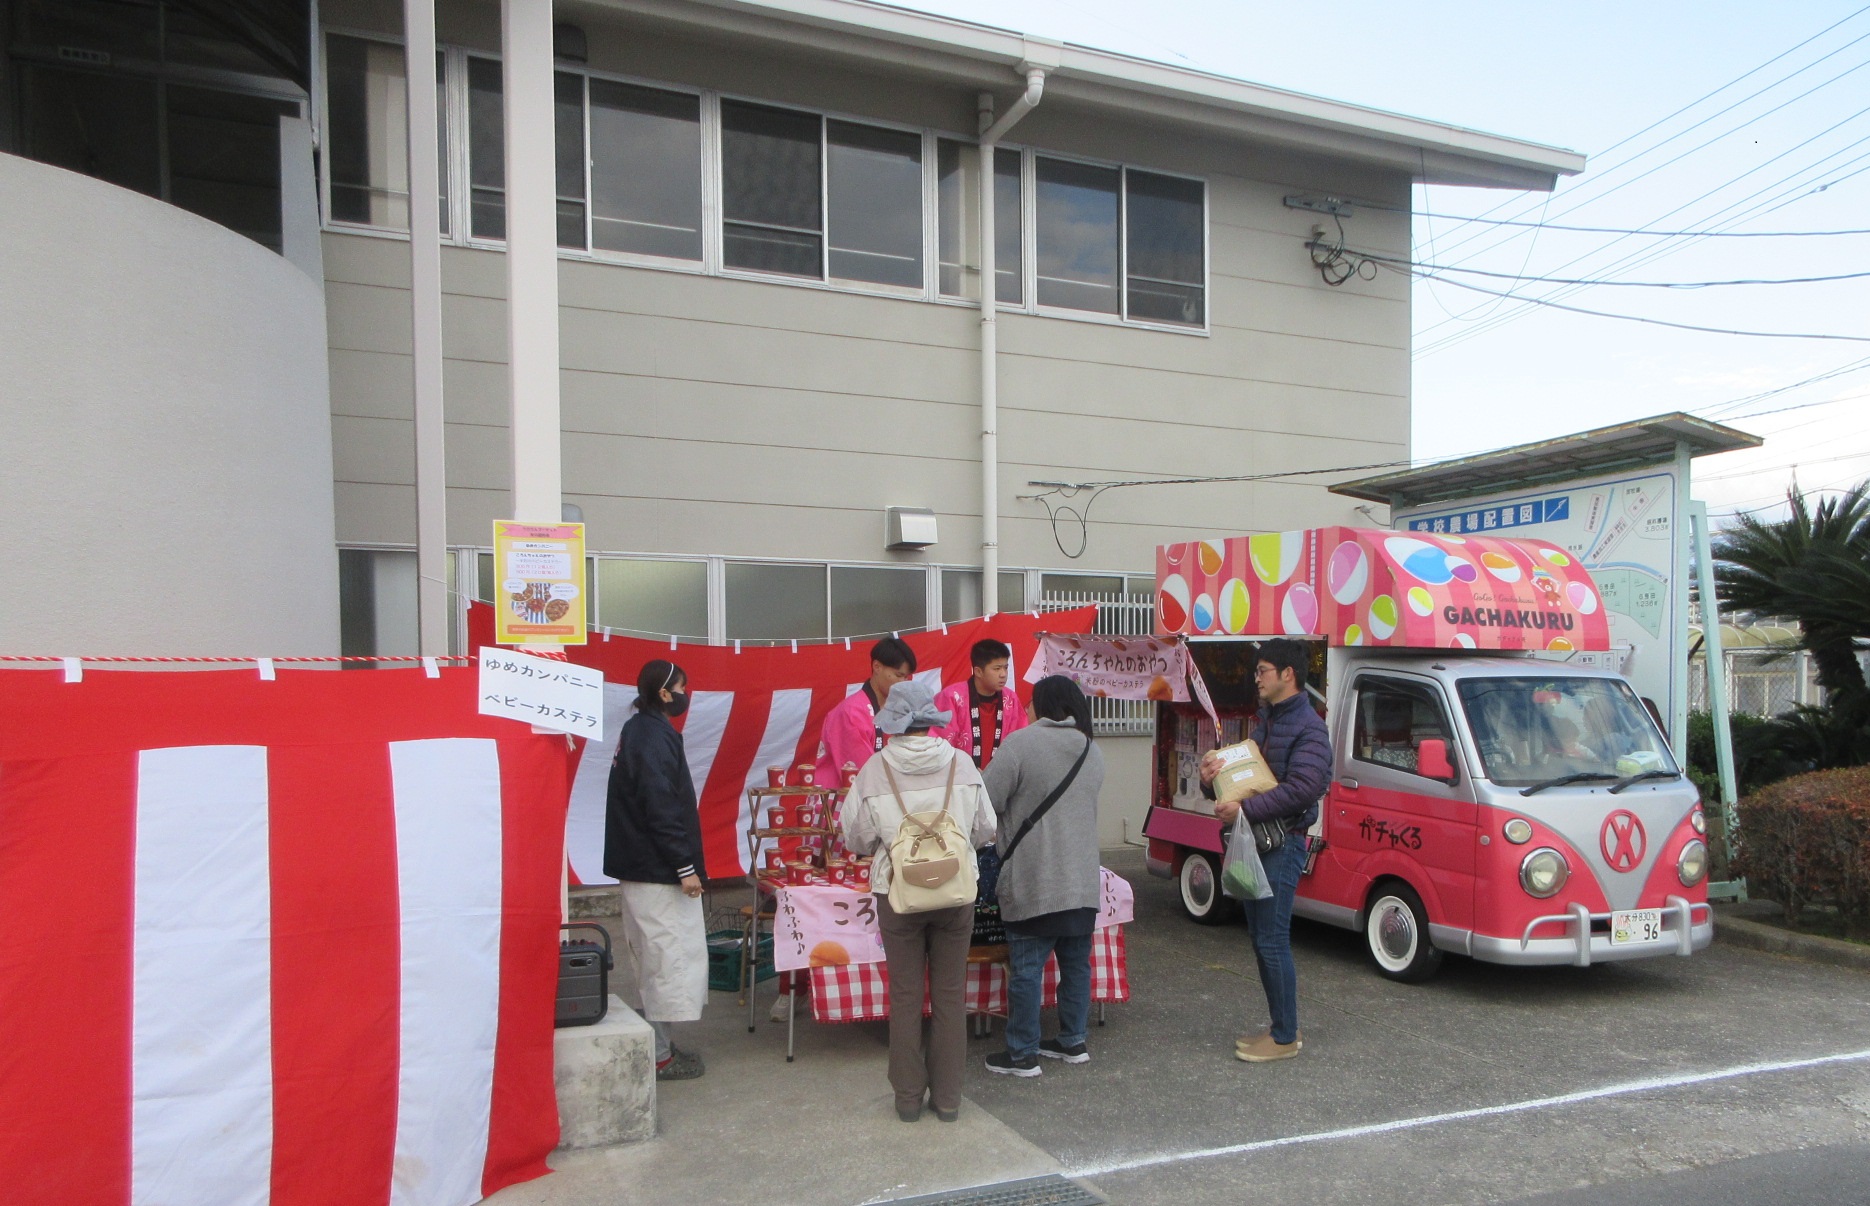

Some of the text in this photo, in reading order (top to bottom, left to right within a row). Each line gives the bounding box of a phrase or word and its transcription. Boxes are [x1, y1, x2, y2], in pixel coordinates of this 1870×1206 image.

[1417, 504, 1533, 533] 学校農場配置図
[1443, 605, 1574, 631] GACHAKURU
[485, 658, 599, 690] ゆめカンパニー
[1058, 649, 1168, 674] ころんちゃんのおやつ
[1085, 676, 1145, 689] 米粉のベビーカステラ
[484, 693, 598, 728] ベビーカステラ
[833, 897, 876, 926] ころ
